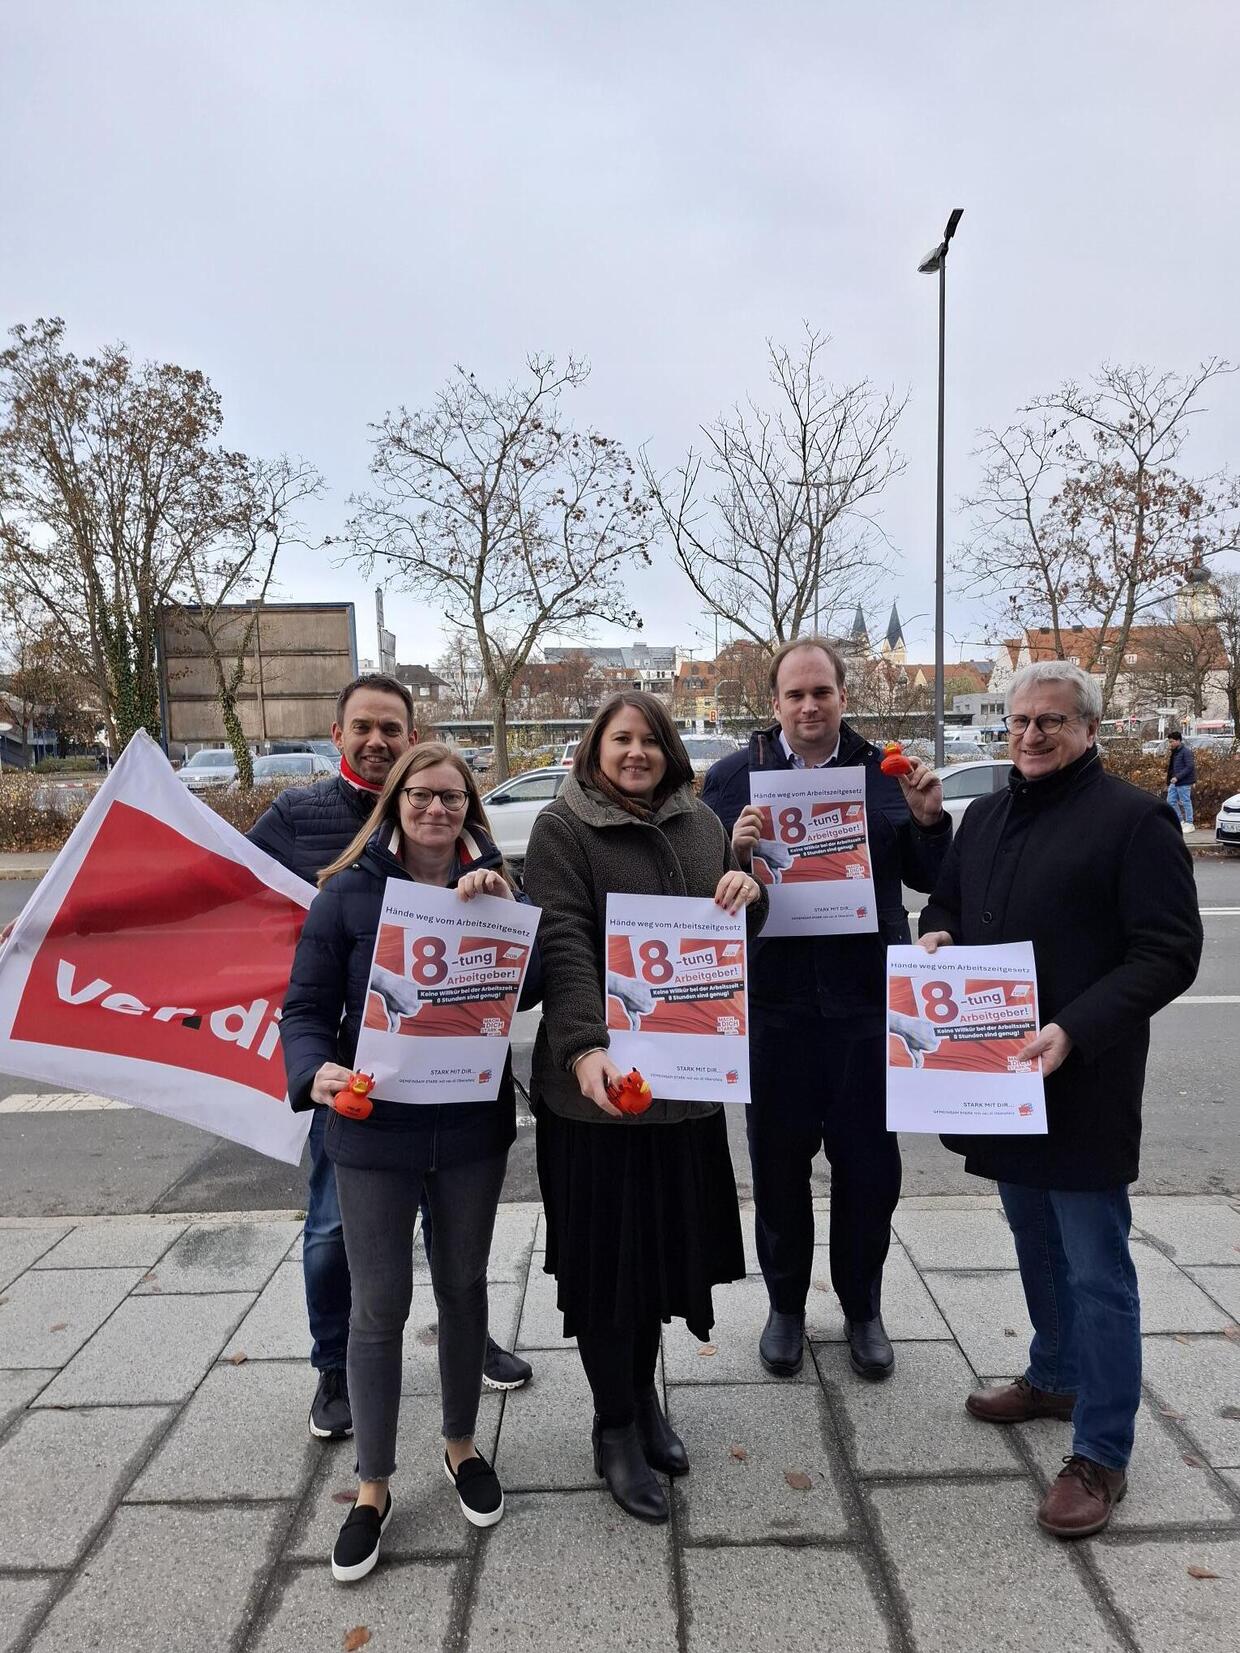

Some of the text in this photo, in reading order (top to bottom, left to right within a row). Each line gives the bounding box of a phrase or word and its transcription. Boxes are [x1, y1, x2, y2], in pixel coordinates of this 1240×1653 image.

[807, 788, 862, 797] Arbeitszeitgesetz
[778, 807, 806, 844] 8
[807, 825, 860, 843] Arbeitgeber!
[386, 906, 530, 938] Hände weg vom Arbeitszeitgesetz
[610, 919, 636, 927] Hände
[638, 921, 654, 930] weg
[673, 922, 741, 932] Arbeitszeitgesetz
[411, 936, 449, 986] 8
[639, 940, 674, 984] 8
[957, 964, 1030, 974] Arbeitszeitgesetz
[447, 970, 516, 985] Arbeitgeber!
[674, 967, 738, 984] Arbeitgeber!
[439, 988, 460, 996] Willkür
[921, 981, 959, 1023] 8
[960, 1008, 1028, 1023] Arbeitgeber!
